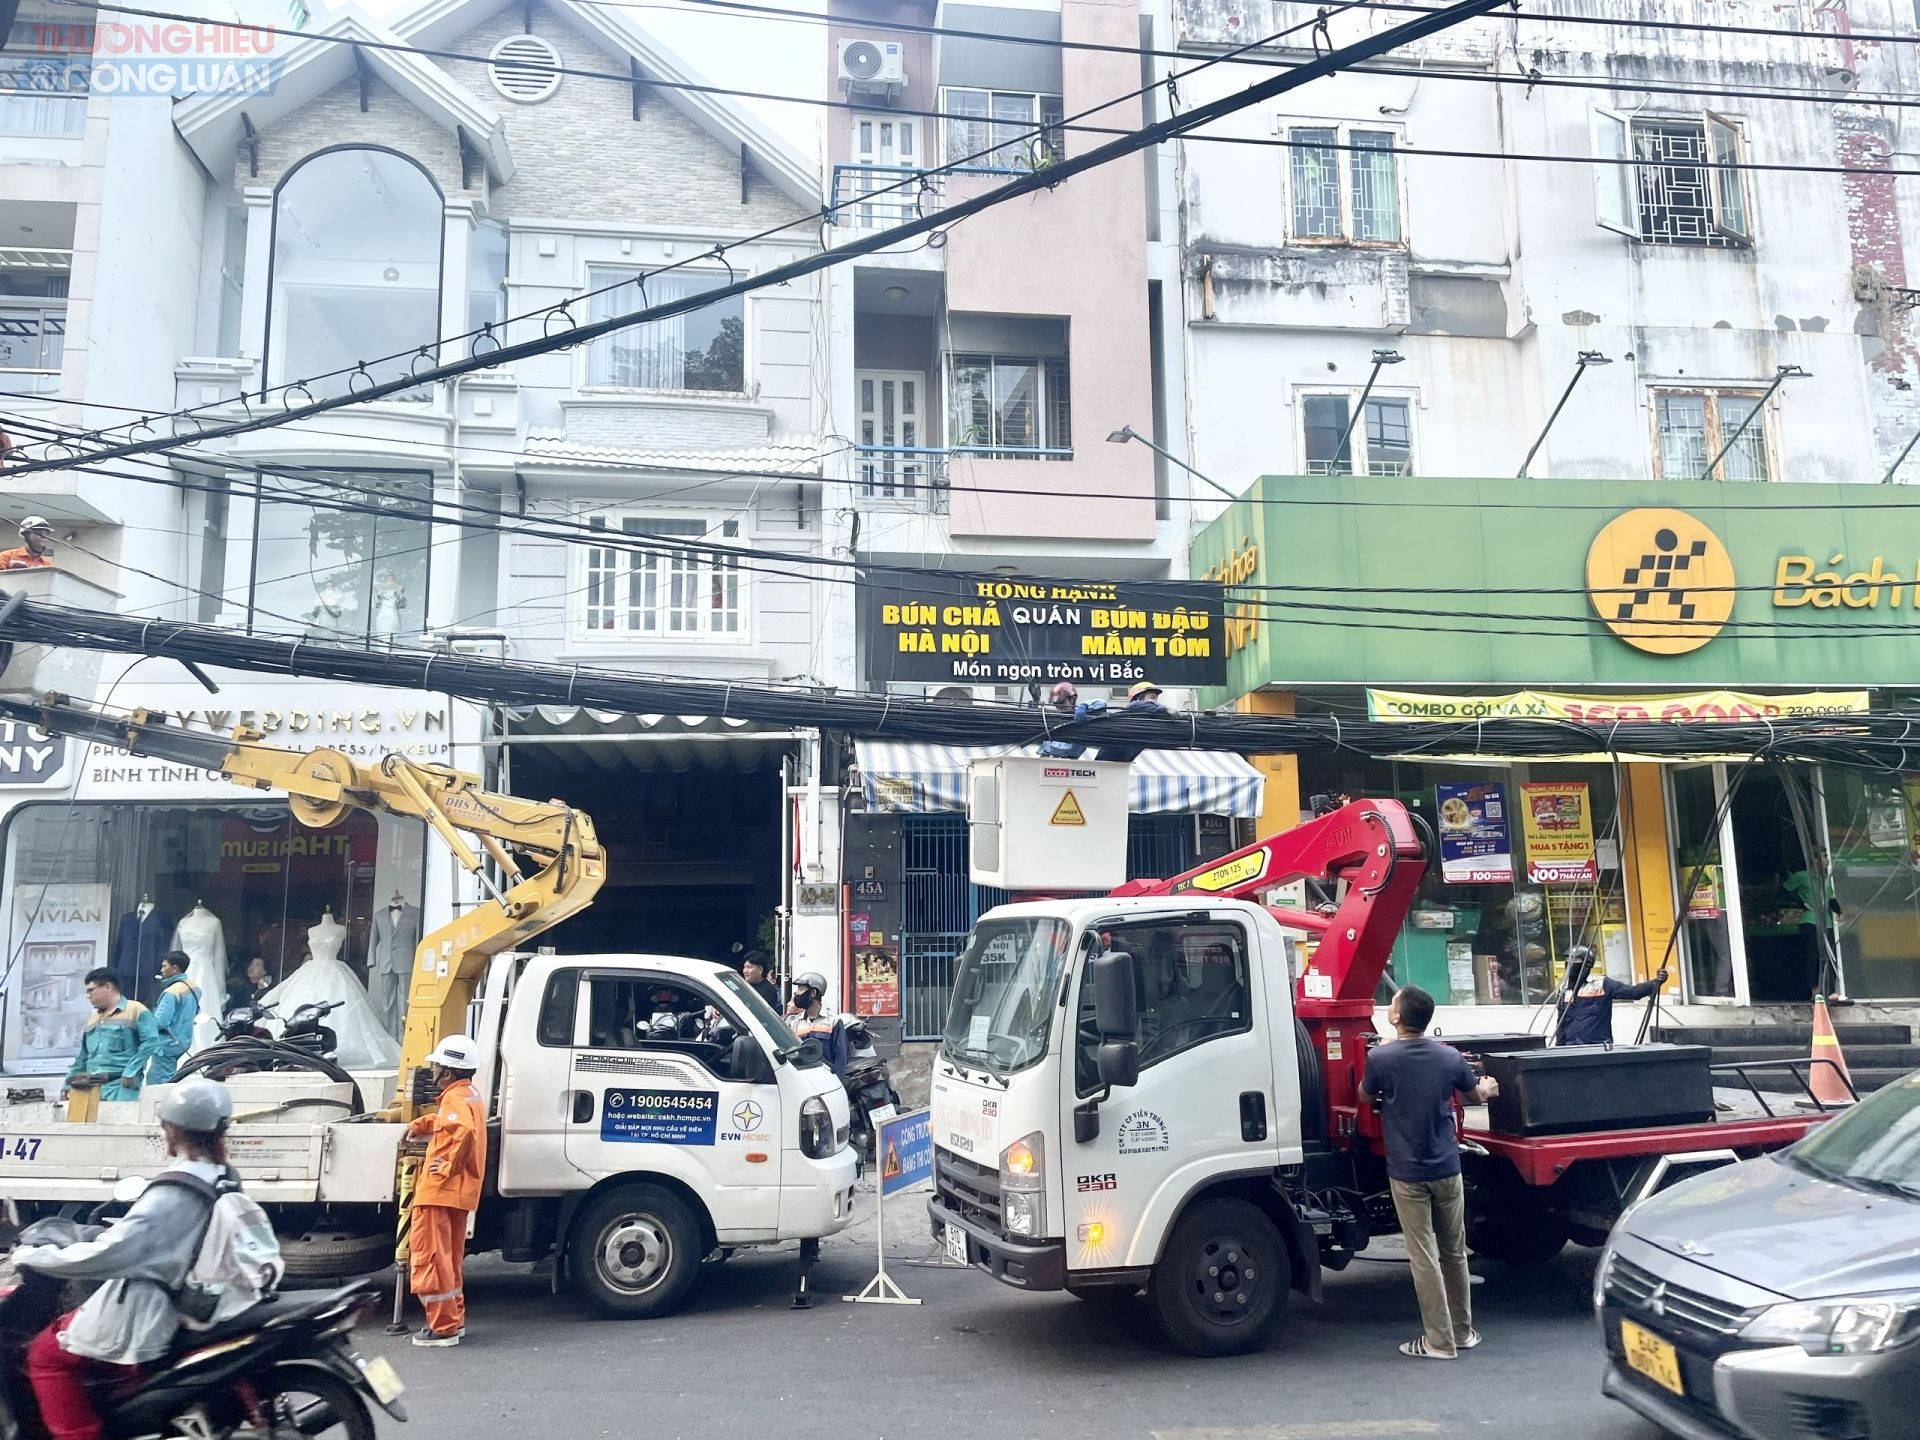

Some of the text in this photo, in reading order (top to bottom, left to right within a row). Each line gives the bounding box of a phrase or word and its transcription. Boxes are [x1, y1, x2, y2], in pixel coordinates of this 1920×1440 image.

[1773, 553, 1901, 609] Bách
[882, 600, 1001, 626] BÚN CHẢ
[1013, 605, 1081, 624] QUÁN
[1091, 605, 1209, 634] BÚN ĐẬU
[899, 628, 990, 658] HÀ NỘI
[1082, 630, 1210, 657] MẮM TÔM
[953, 660, 1144, 682] Món ngon tròn vị Bắc
[1387, 702, 1456, 716] COMBO
[1070, 769, 1096, 777] TECH
[445, 797, 469, 810] DHS
[1531, 842, 1551, 851] MUA
[1558, 841, 1584, 853] TẶNG
[1229, 863, 1242, 877] 125
[1472, 871, 1491, 880] 100
[1532, 868, 1558, 881] 100
[857, 881, 883, 894] 45A
[24, 909, 102, 923] VIVIAN
[983, 952, 1007, 962] 35K
[630, 1095, 712, 1109] 1900545454
[982, 1099, 997, 1110] QKR
[627, 1112, 656, 1120] website:
[658, 1113, 711, 1124] cskh.hcmpc.vn
[982, 1108, 997, 1117] 230
[1136, 1121, 1150, 1129] 3N
[901, 1123, 916, 1146] CÔNG
[1077, 1173, 1116, 1184] QKR
[1077, 1182, 1117, 1192] 230
